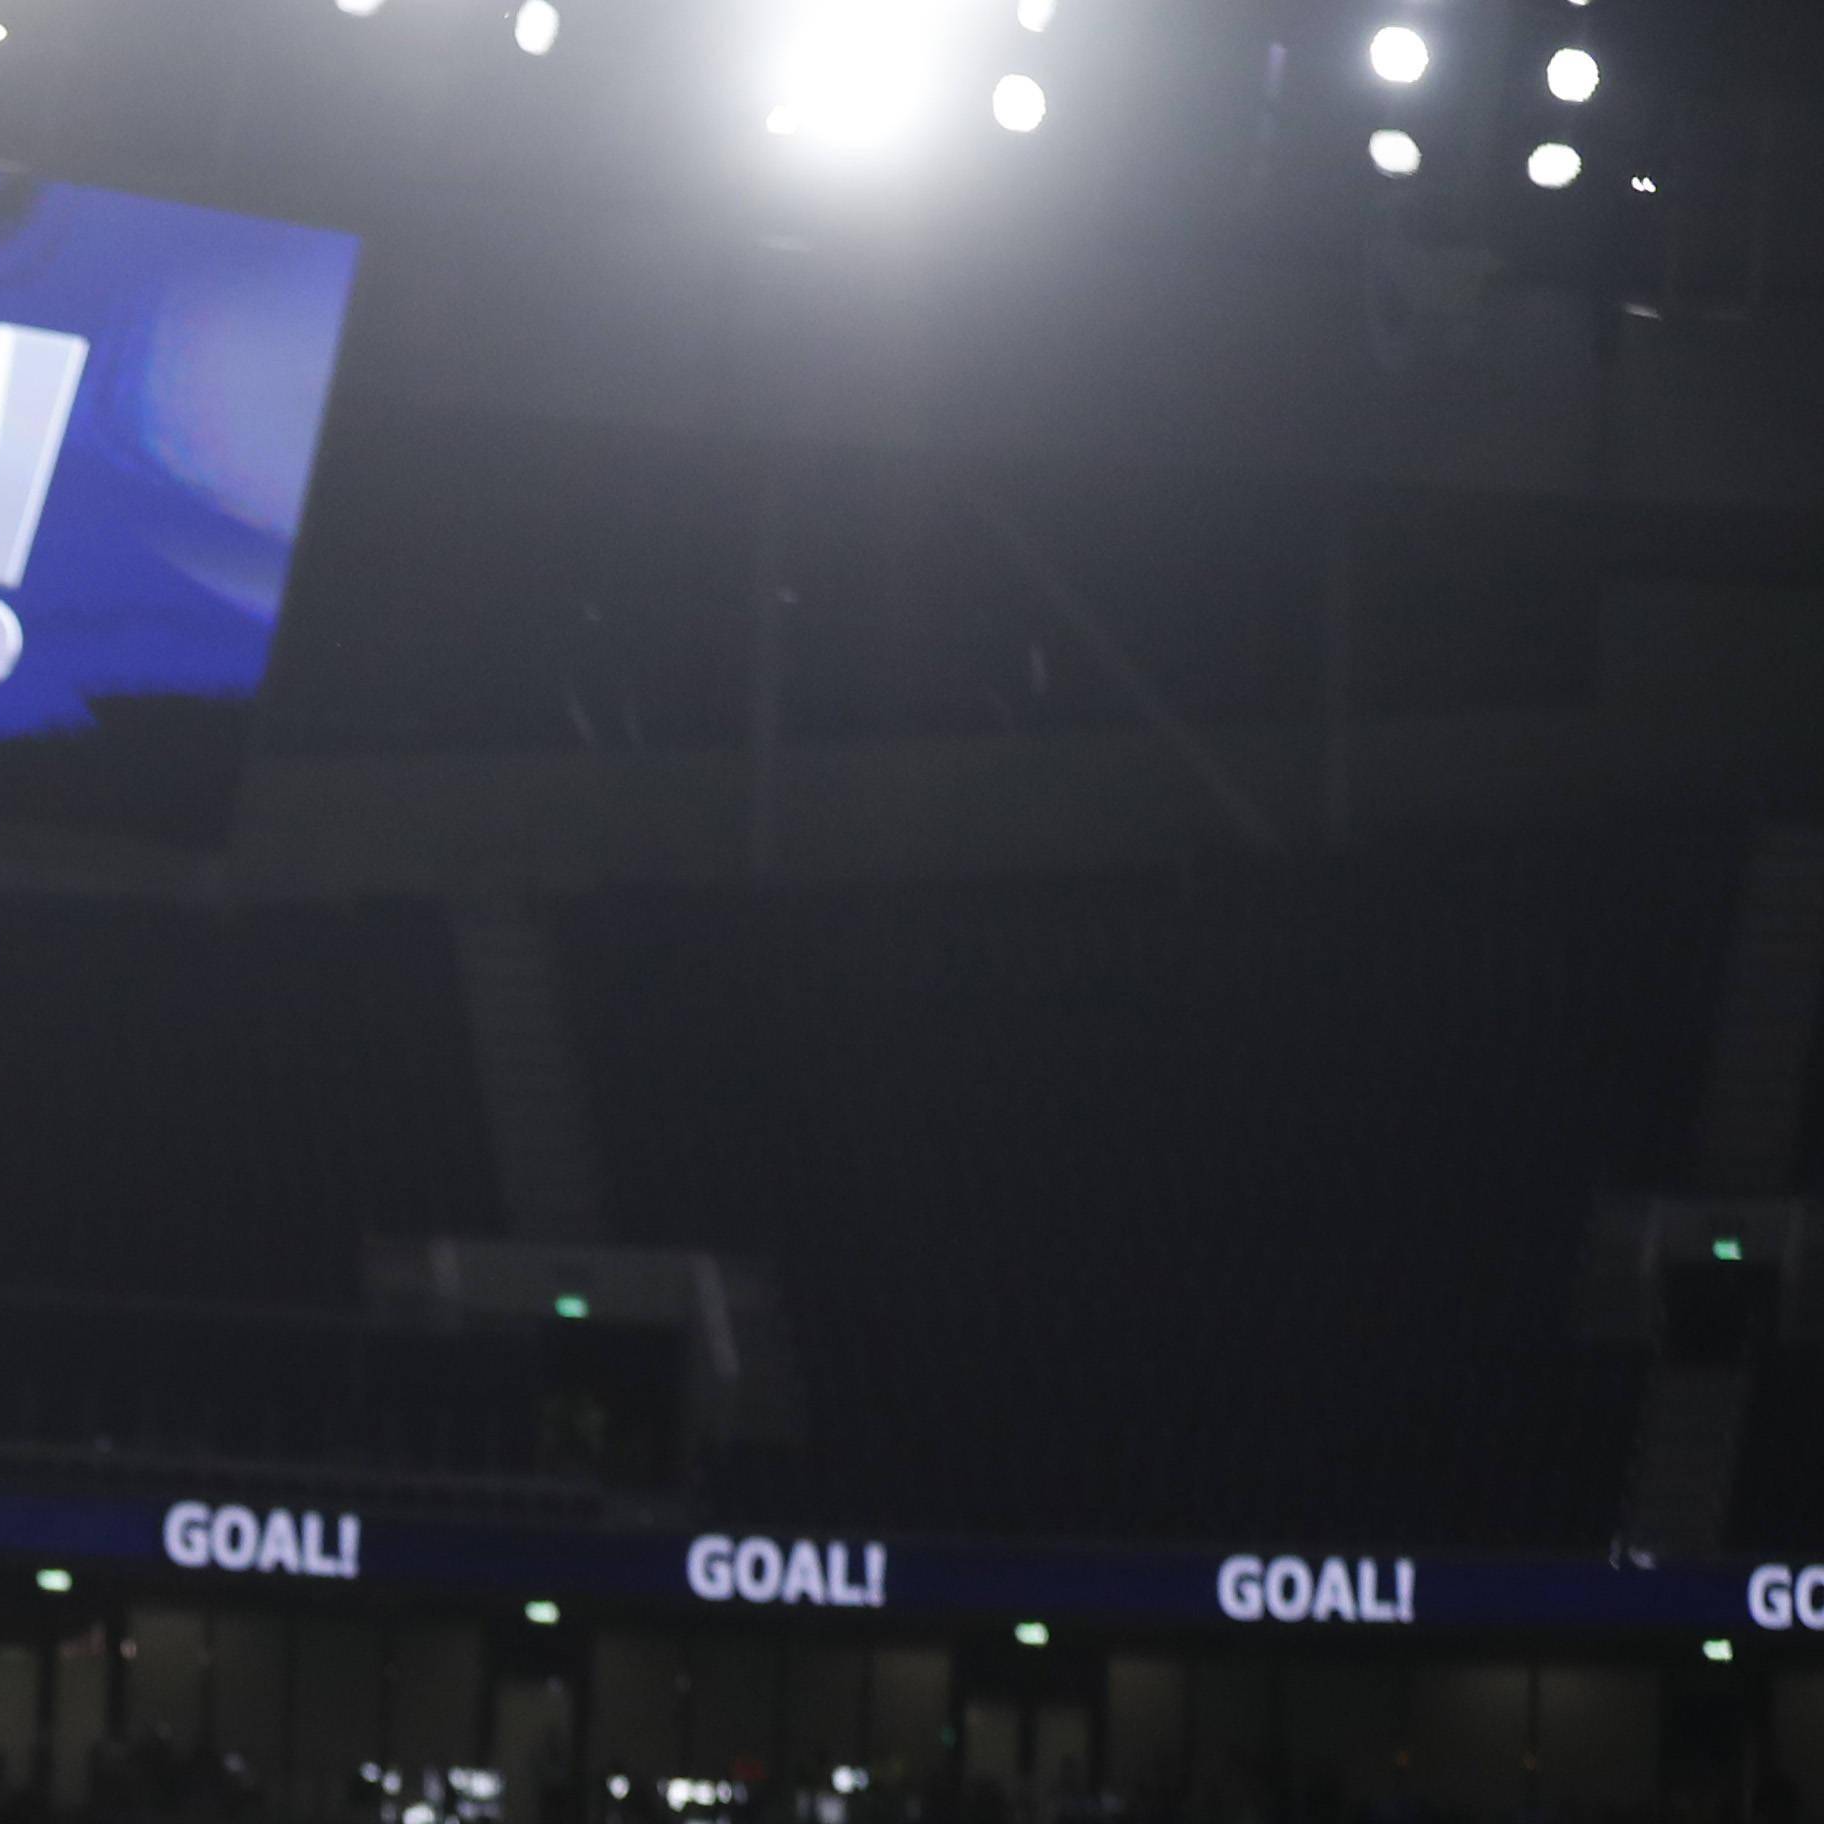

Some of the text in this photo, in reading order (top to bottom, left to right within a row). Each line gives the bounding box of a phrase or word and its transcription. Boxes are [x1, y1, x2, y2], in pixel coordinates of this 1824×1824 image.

[163, 1499, 361, 1580] GOAL!
[686, 1532, 888, 1609] GOAL!
[1216, 1554, 1417, 1625] GOAL!
